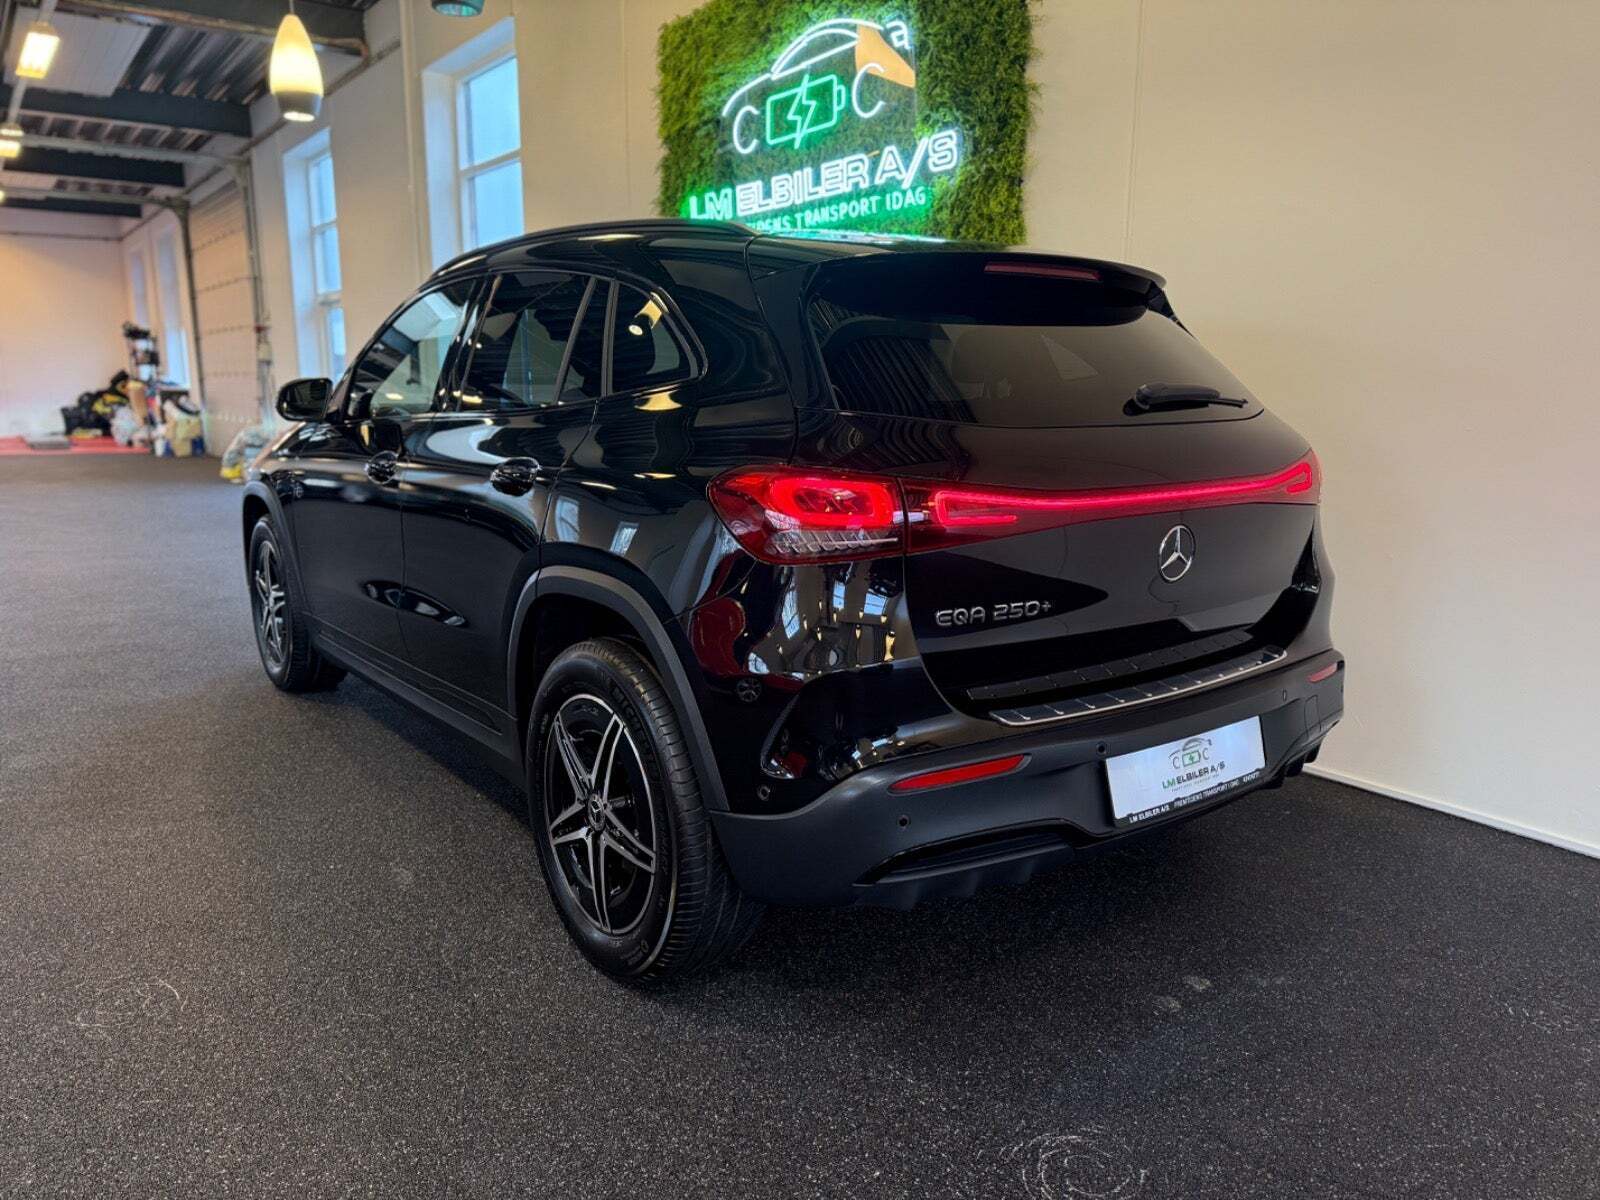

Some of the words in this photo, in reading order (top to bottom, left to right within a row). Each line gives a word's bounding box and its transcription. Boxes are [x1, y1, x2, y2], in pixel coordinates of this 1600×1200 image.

[689, 187, 733, 220] LM
[735, 154, 869, 217] ELBILER
[875, 129, 957, 190] A/S
[794, 195, 881, 230] TRANSPORT
[936, 606, 986, 626] EQA
[993, 600, 1051, 620] 250+
[1162, 777, 1176, 789] LM
[1176, 767, 1209, 784] ELBILER
[1210, 760, 1226, 773] A/S
